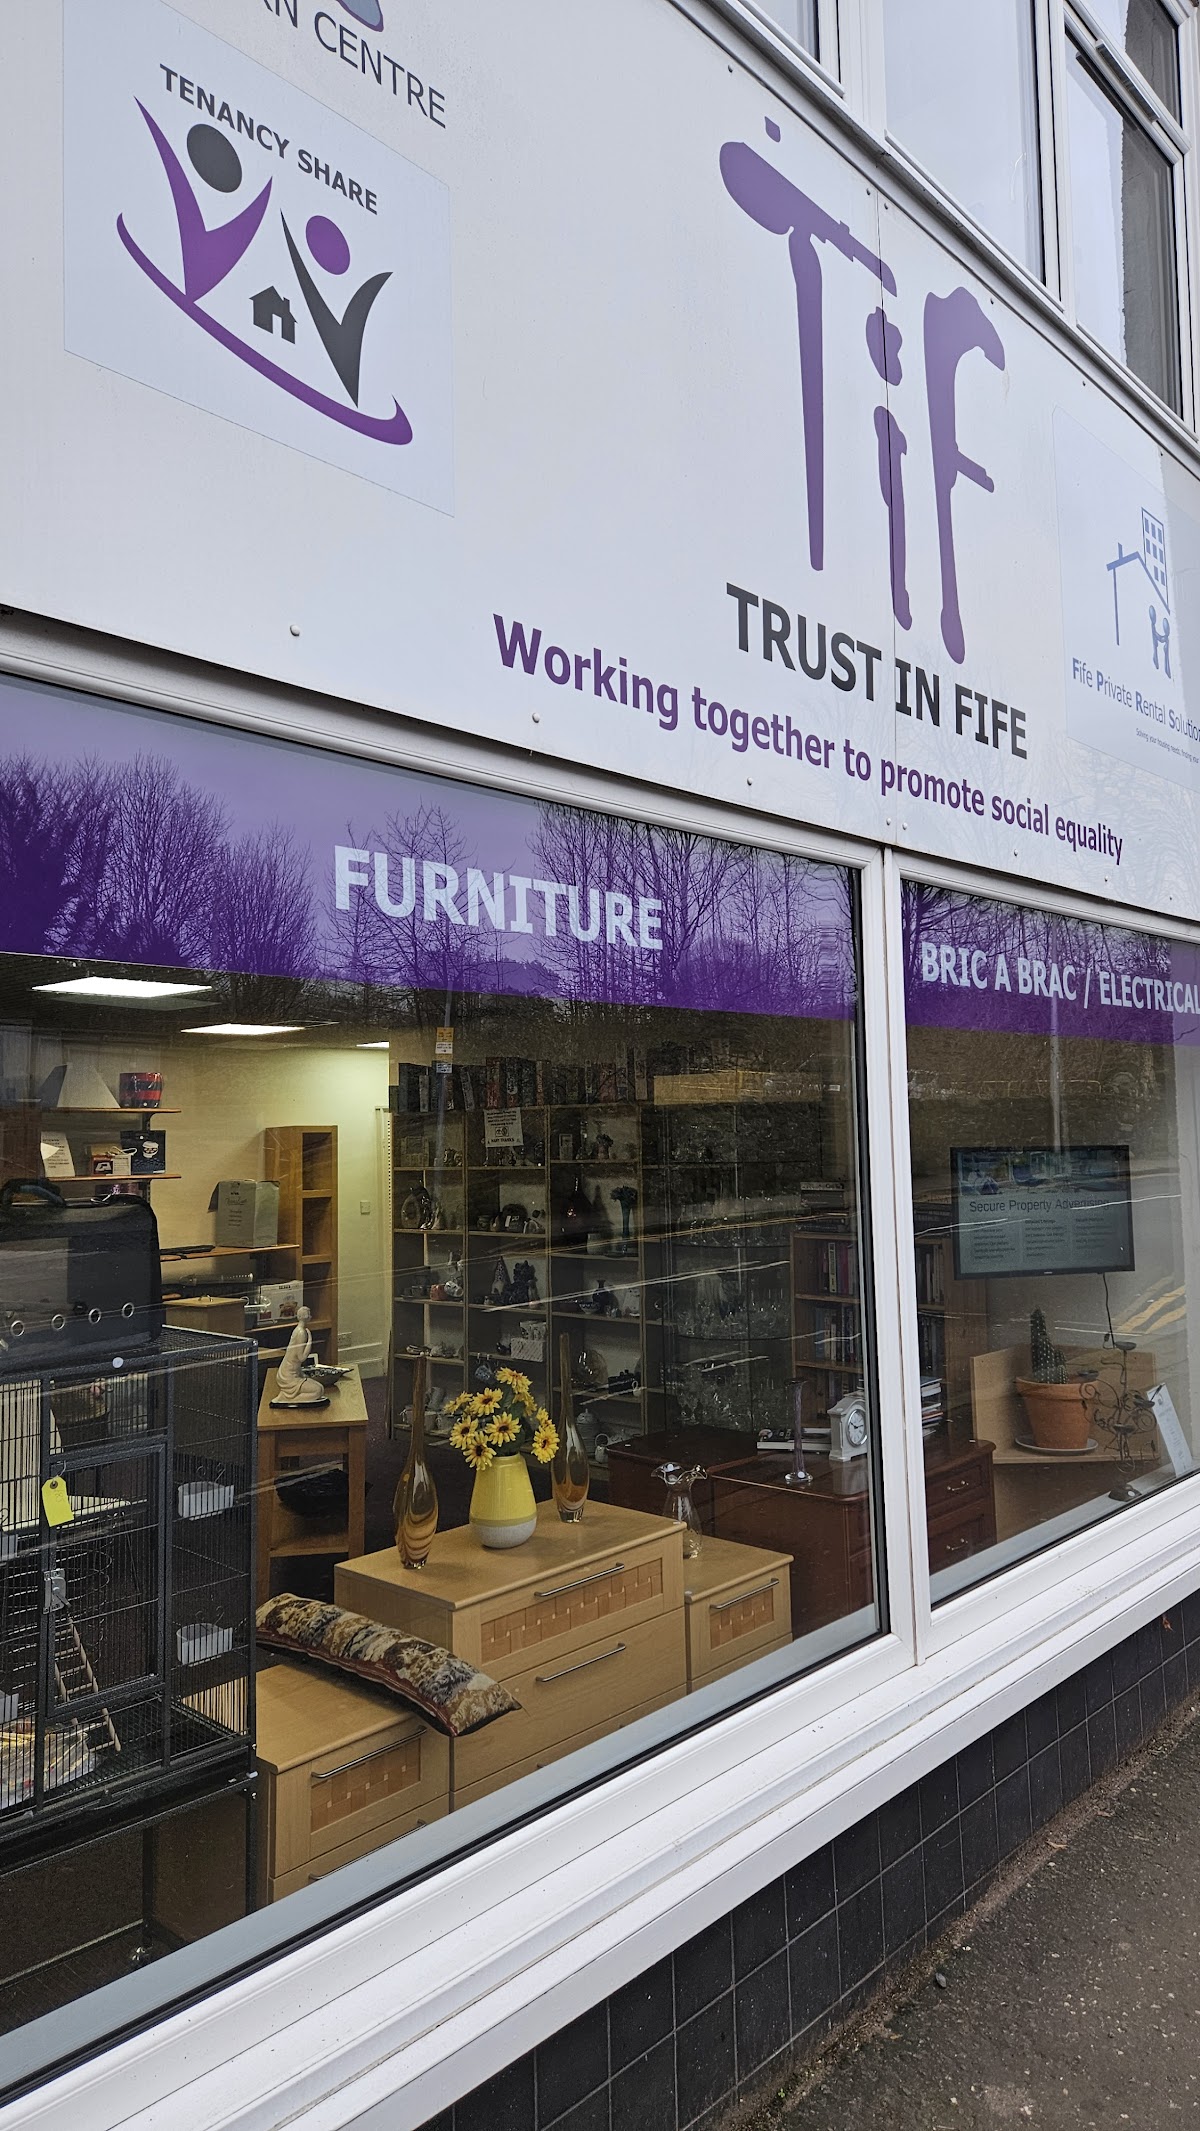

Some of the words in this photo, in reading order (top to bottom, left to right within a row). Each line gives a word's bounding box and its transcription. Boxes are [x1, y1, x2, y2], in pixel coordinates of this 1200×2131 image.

[313, 11, 446, 130] CENTRE
[159, 63, 290, 159] TENANCY
[297, 148, 378, 216] SHARE
[726, 582, 882, 702] TRUST
[895, 657, 940, 728] IN
[955, 683, 1028, 760] FIFE
[1072, 657, 1093, 688] Fife
[1096, 670, 1132, 708] Private
[1135, 690, 1166, 725] Rental
[493, 613, 679, 731] Working
[692, 686, 835, 769] together
[843, 738, 872, 781] to
[881, 758, 985, 817] promote
[991, 796, 1050, 836] social
[1056, 815, 1123, 866] equality
[334, 845, 663, 950] FURNITURE
[921, 942, 988, 990] BRIC
[994, 954, 1012, 993] A
[1018, 957, 1077, 1001] BRAC
[1083, 967, 1092, 1009] /
[1100, 971, 1200, 1016] ELECTRICAL
[969, 1200, 1006, 1213] Secure
[1009, 1199, 1051, 1213] Property
